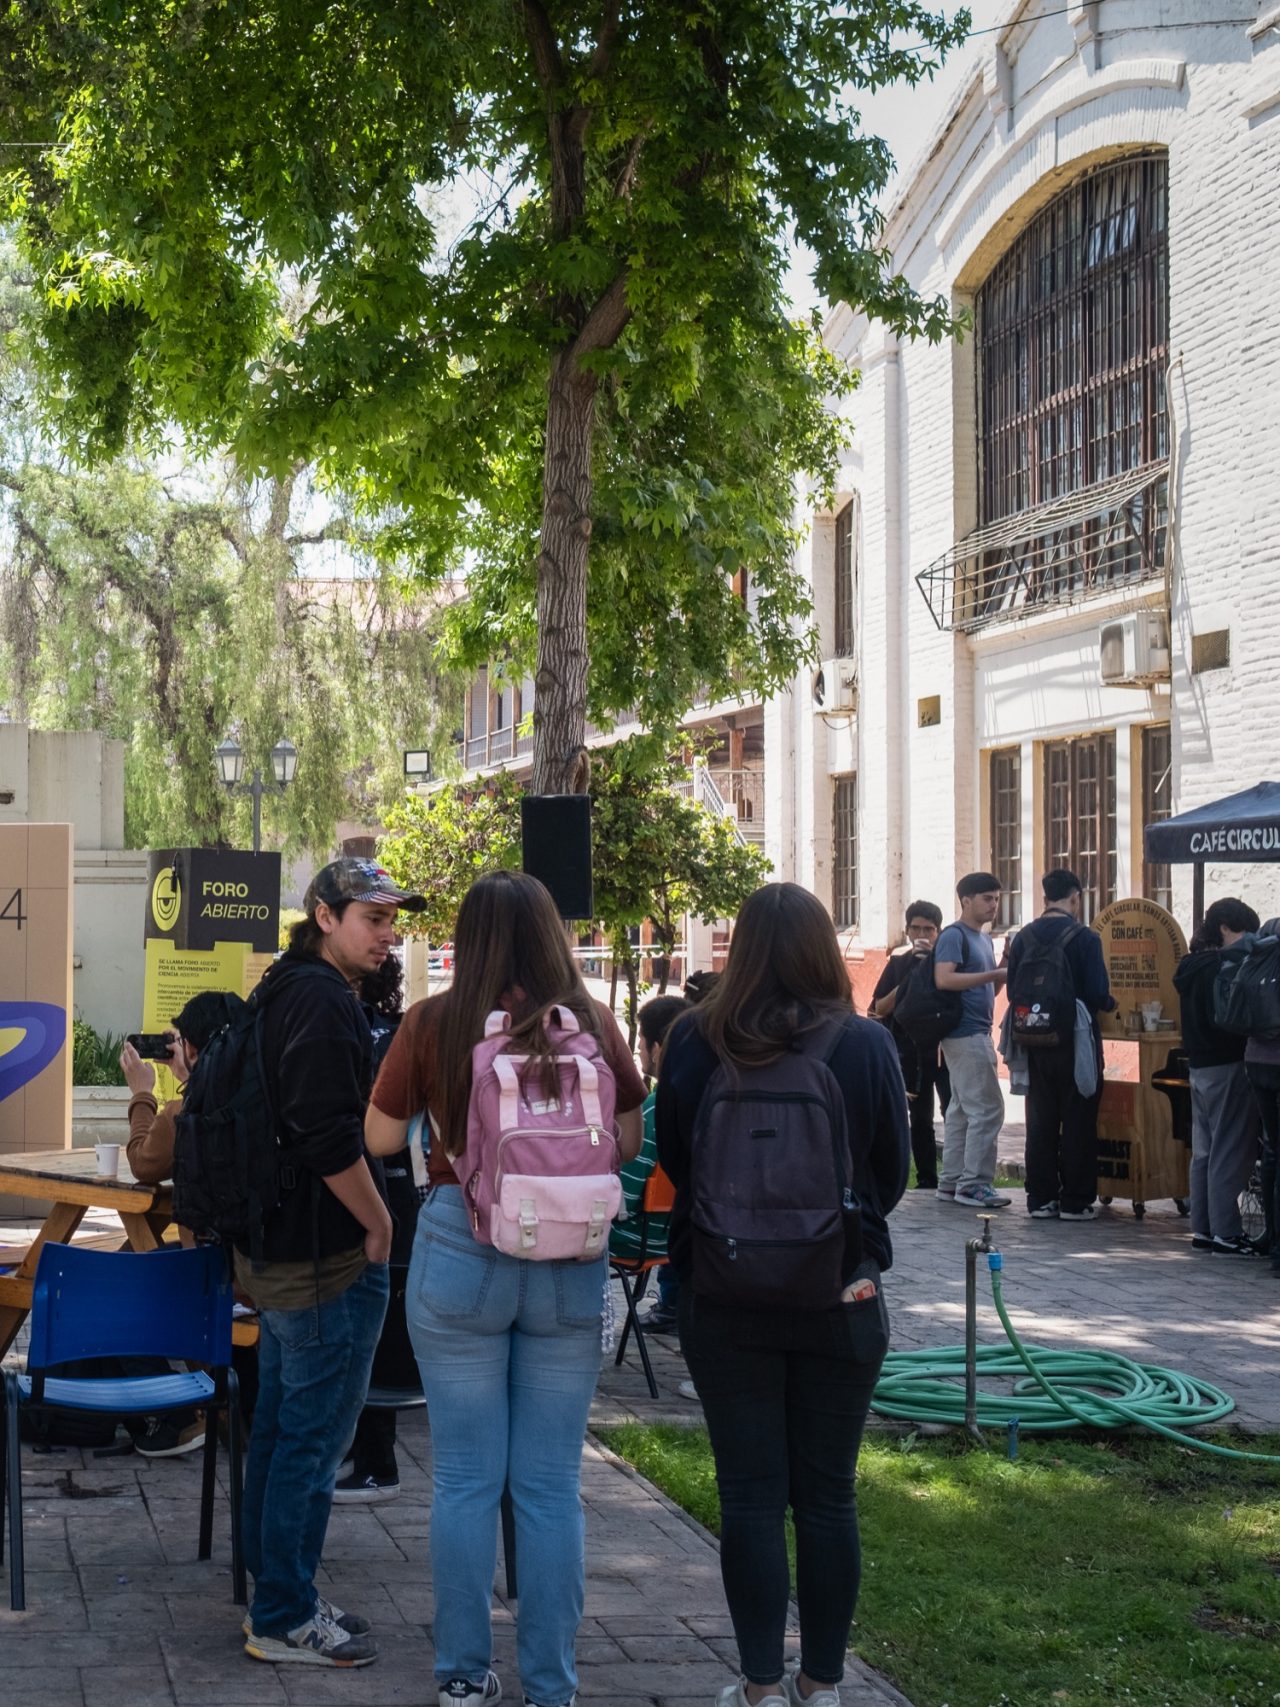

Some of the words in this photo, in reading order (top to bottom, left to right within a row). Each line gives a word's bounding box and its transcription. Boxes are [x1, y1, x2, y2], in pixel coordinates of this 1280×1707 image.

[202, 881, 248, 898] FORO
[200, 903, 269, 920] ABIERTO
[1111, 928, 1126, 940] CON
[1126, 924, 1143, 940] CAFÉ
